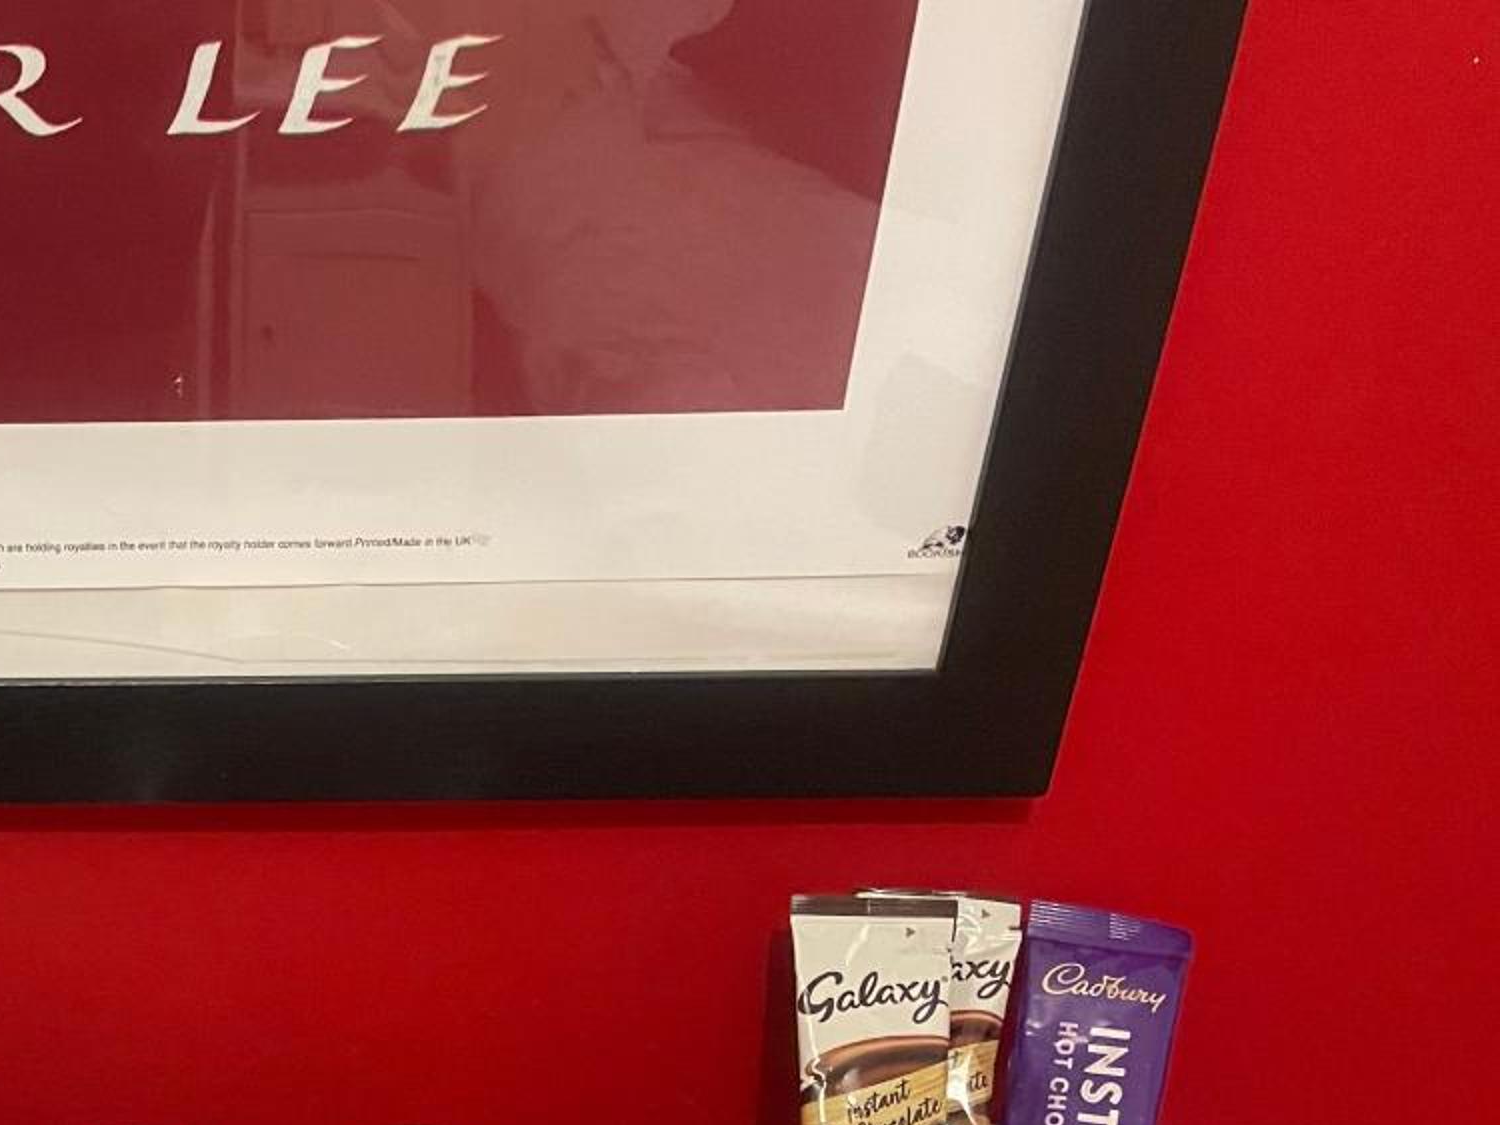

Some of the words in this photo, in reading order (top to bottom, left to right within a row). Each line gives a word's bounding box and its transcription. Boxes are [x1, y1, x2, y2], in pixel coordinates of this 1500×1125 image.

[166, 33, 503, 137] LEE
[7, 543, 23, 552] are
[25, 542, 61, 554] holding
[63, 542, 105, 553] royalties
[120, 541, 135, 551] the
[137, 542, 165, 551] event
[168, 540, 187, 550] that
[189, 540, 206, 550] the
[207, 540, 241, 551] royalty
[243, 540, 275, 549] holder
[277, 540, 312, 549] comes
[314, 538, 352, 548] forward
[436, 537, 453, 546] the
[456, 536, 473, 546] UK
[798, 971, 949, 1024] Galaxy
[1041, 962, 1167, 1014] Cadbury
[1053, 1021, 1080, 1070] HOT
